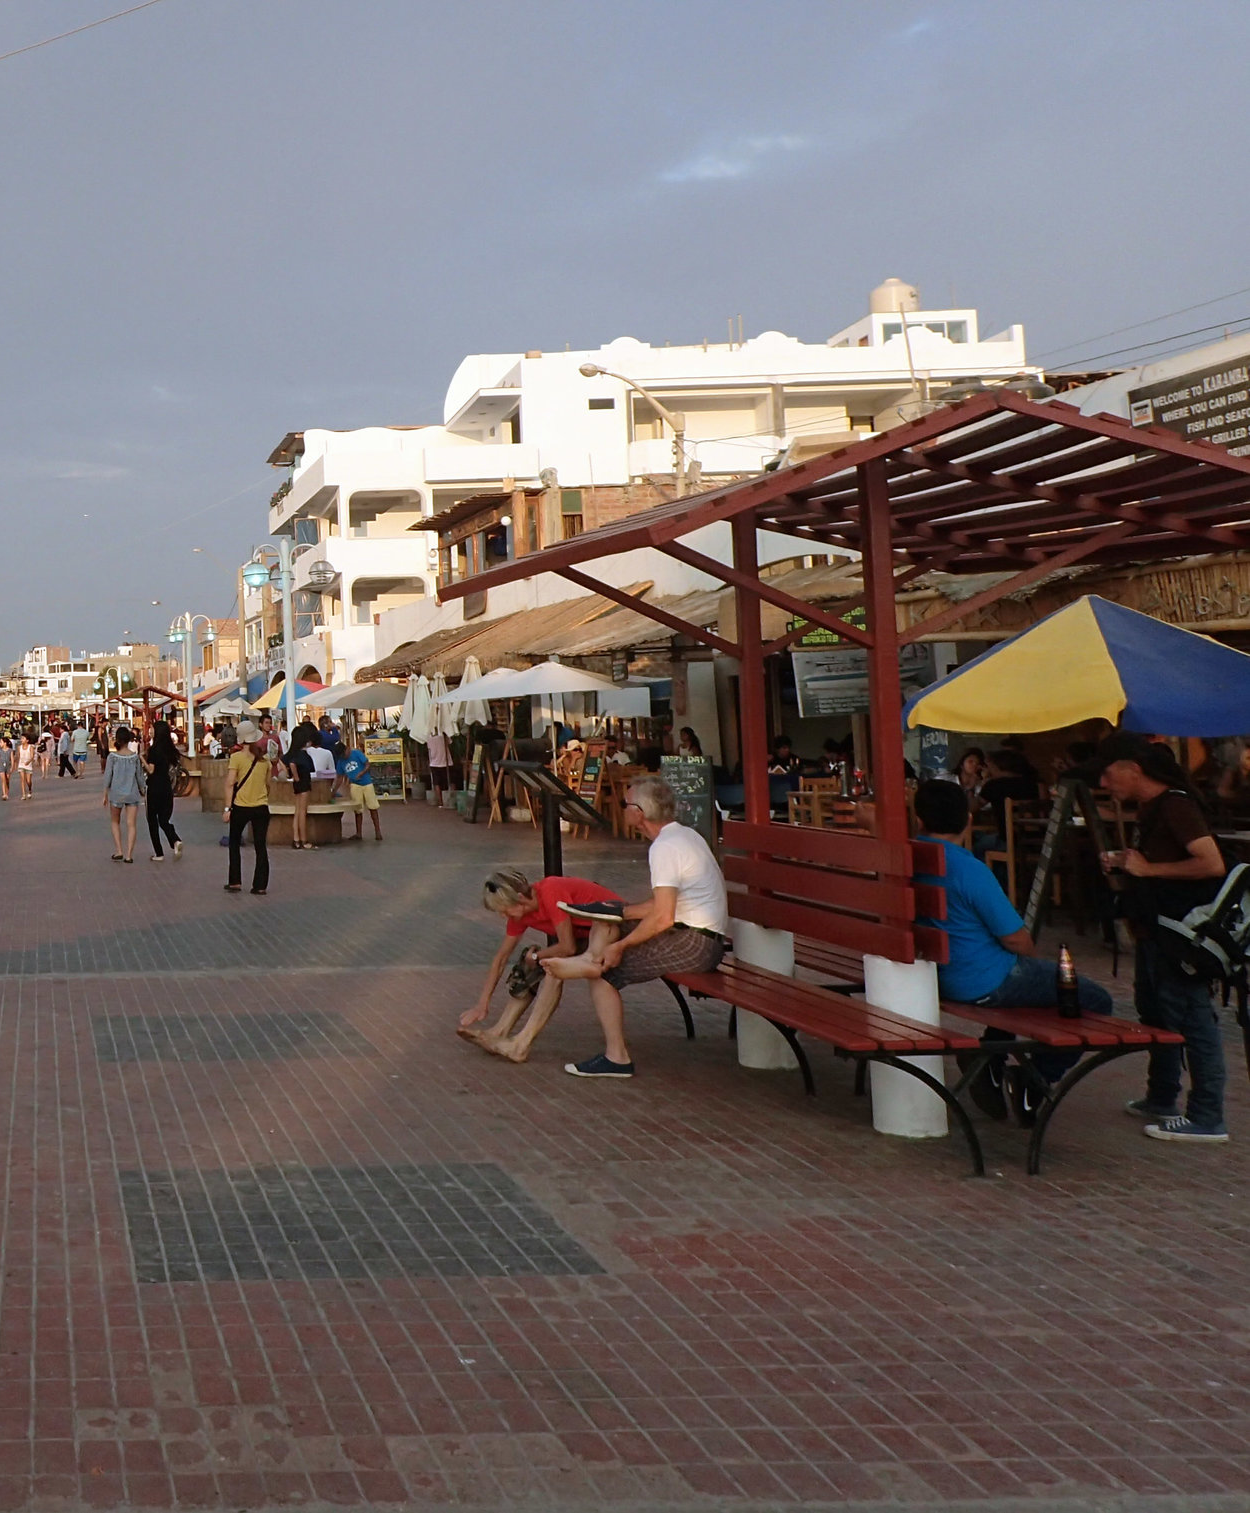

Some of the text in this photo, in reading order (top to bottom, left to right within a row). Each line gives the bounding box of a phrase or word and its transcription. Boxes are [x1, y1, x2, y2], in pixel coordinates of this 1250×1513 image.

[1152, 389, 1190, 408] WELCOME
[1191, 386, 1203, 397] TO
[1162, 406, 1190, 423] WHERE
[1190, 401, 1207, 415] YOU
[1209, 396, 1226, 410] CAN
[1228, 390, 1248, 404] FIND
[1187, 420, 1206, 433] FISH
[1207, 415, 1224, 428] AND
[1212, 427, 1248, 444] GRILLED
